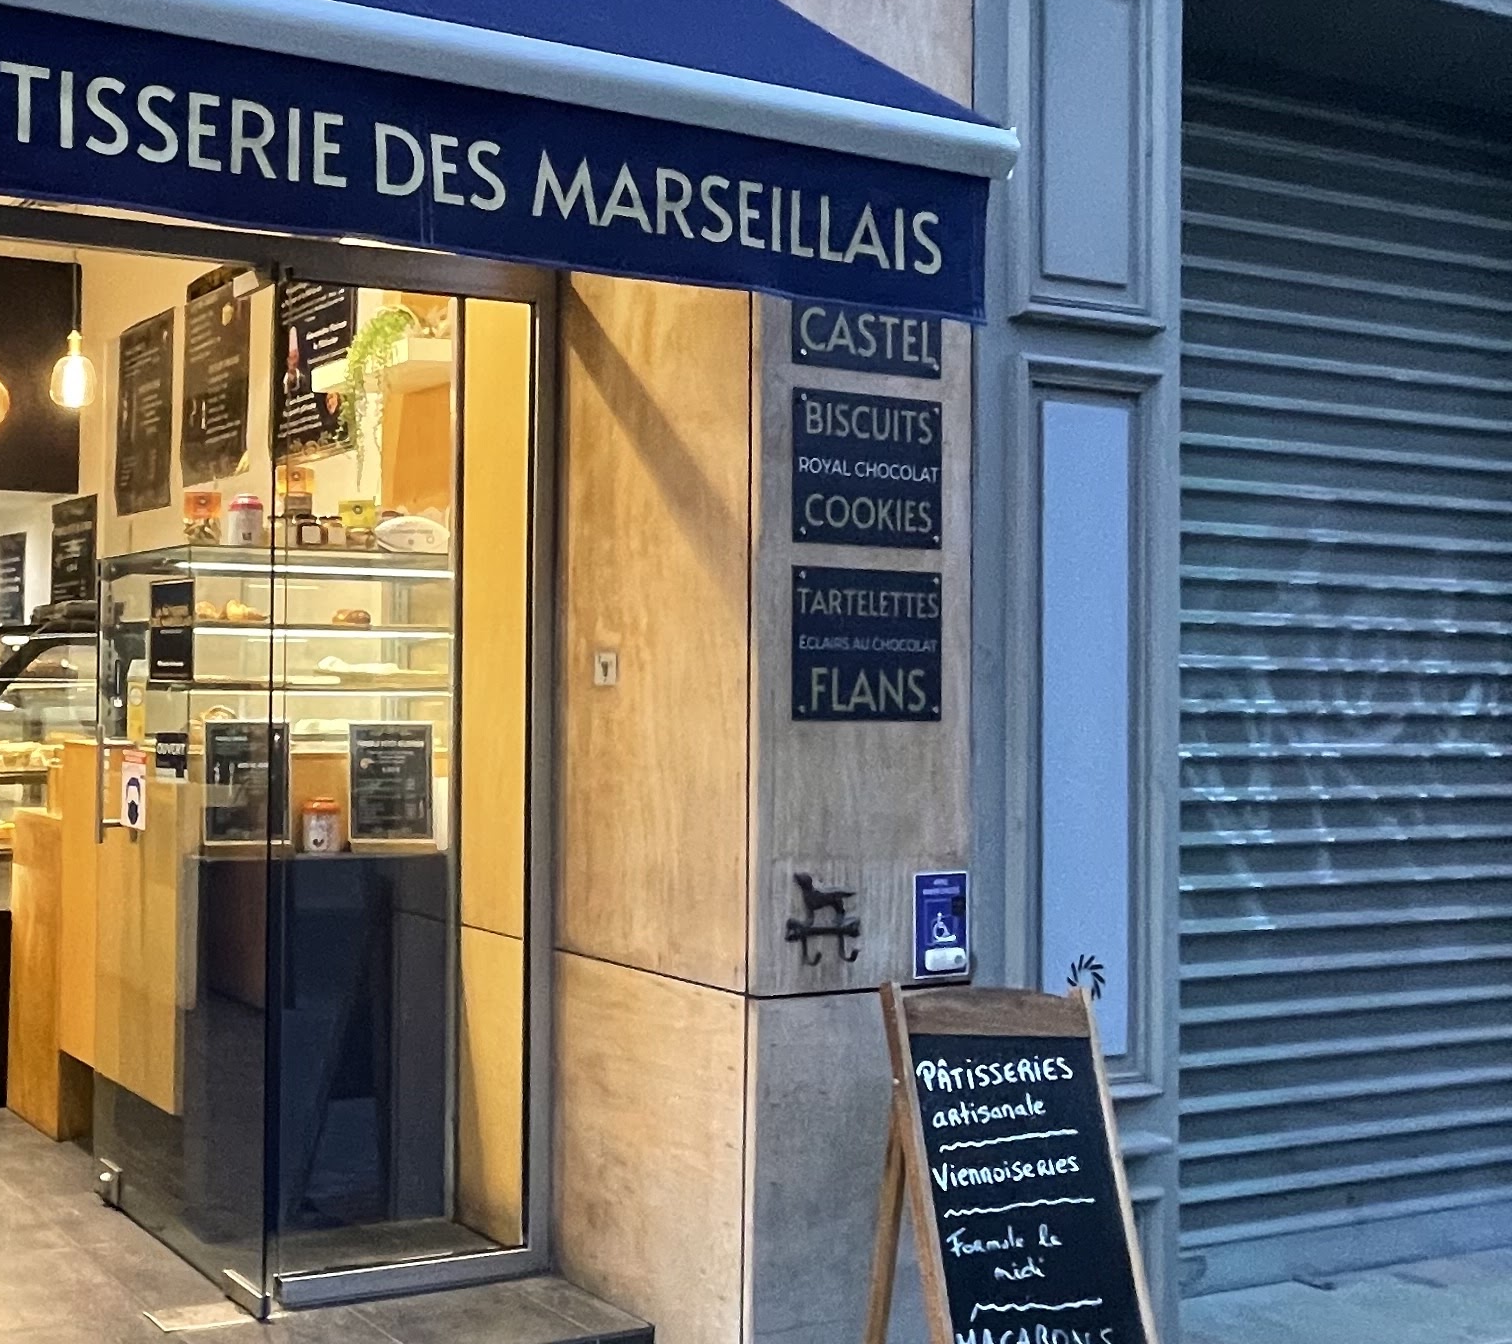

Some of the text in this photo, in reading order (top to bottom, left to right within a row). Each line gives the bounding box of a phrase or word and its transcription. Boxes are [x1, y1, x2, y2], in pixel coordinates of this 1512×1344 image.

[374, 121, 507, 213] DES
[532, 149, 944, 276] MARSEILLAIS
[799, 306, 937, 365] CASTEL
[805, 400, 934, 446] BISCUITS
[798, 455, 940, 484] ROYAL CHOCOLAT
[804, 492, 934, 534] COOKIES
[796, 587, 940, 620] TARTELETTES
[850, 637, 870, 651] AU
[871, 637, 938, 654] CHOCOLAT
[810, 666, 927, 713] FLANS
